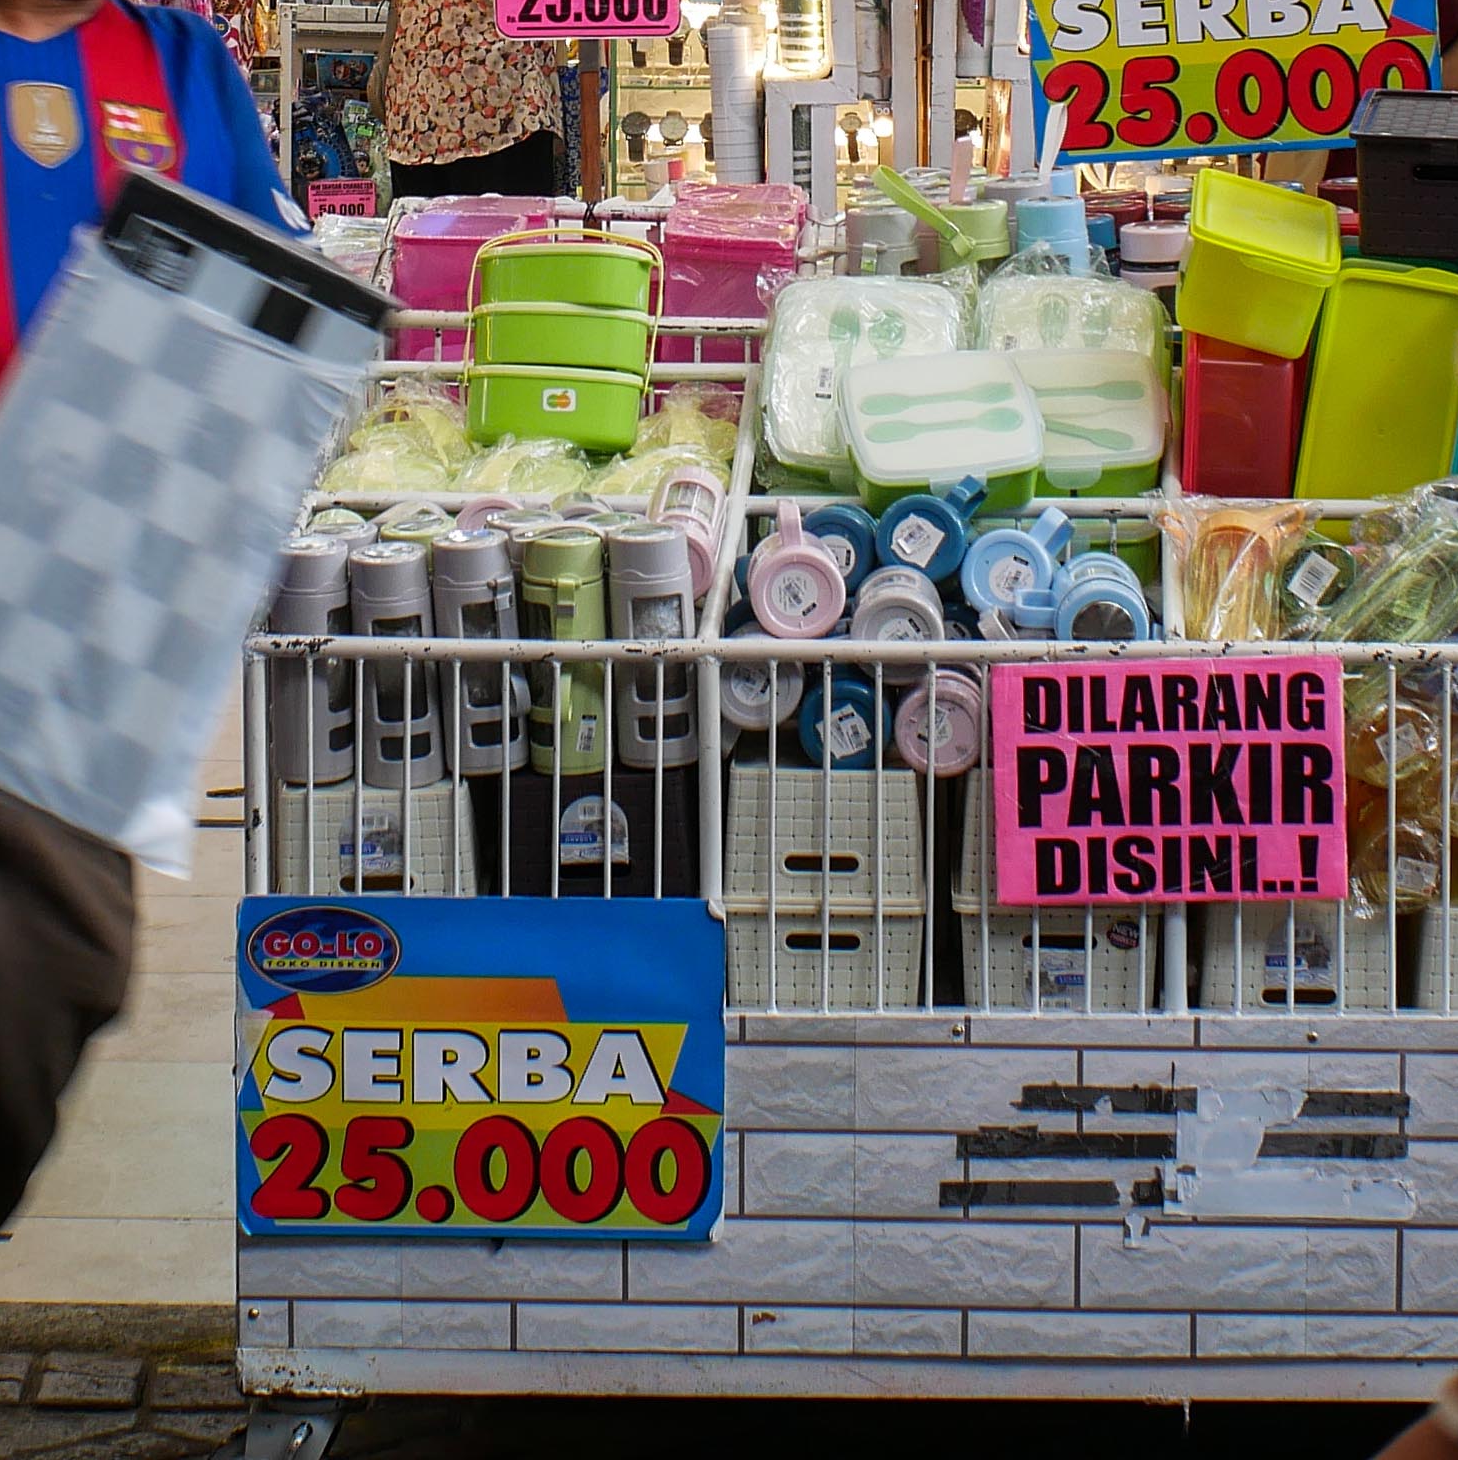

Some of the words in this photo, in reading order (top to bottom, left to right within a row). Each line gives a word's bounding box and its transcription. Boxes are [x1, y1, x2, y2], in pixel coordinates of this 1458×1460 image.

[1042, 38, 1431, 150] 25.000
[1021, 671, 1326, 733] DILARANG
[1015, 741, 1334, 828] PARKIR
[1034, 833, 1320, 896] DISINI..!
[262, 930, 385, 960] GO-LO
[266, 960, 311, 969] TOKO
[318, 960, 381, 969] DISKON
[262, 1025, 669, 1105] SERBA
[249, 1113, 712, 1225] 25.000
